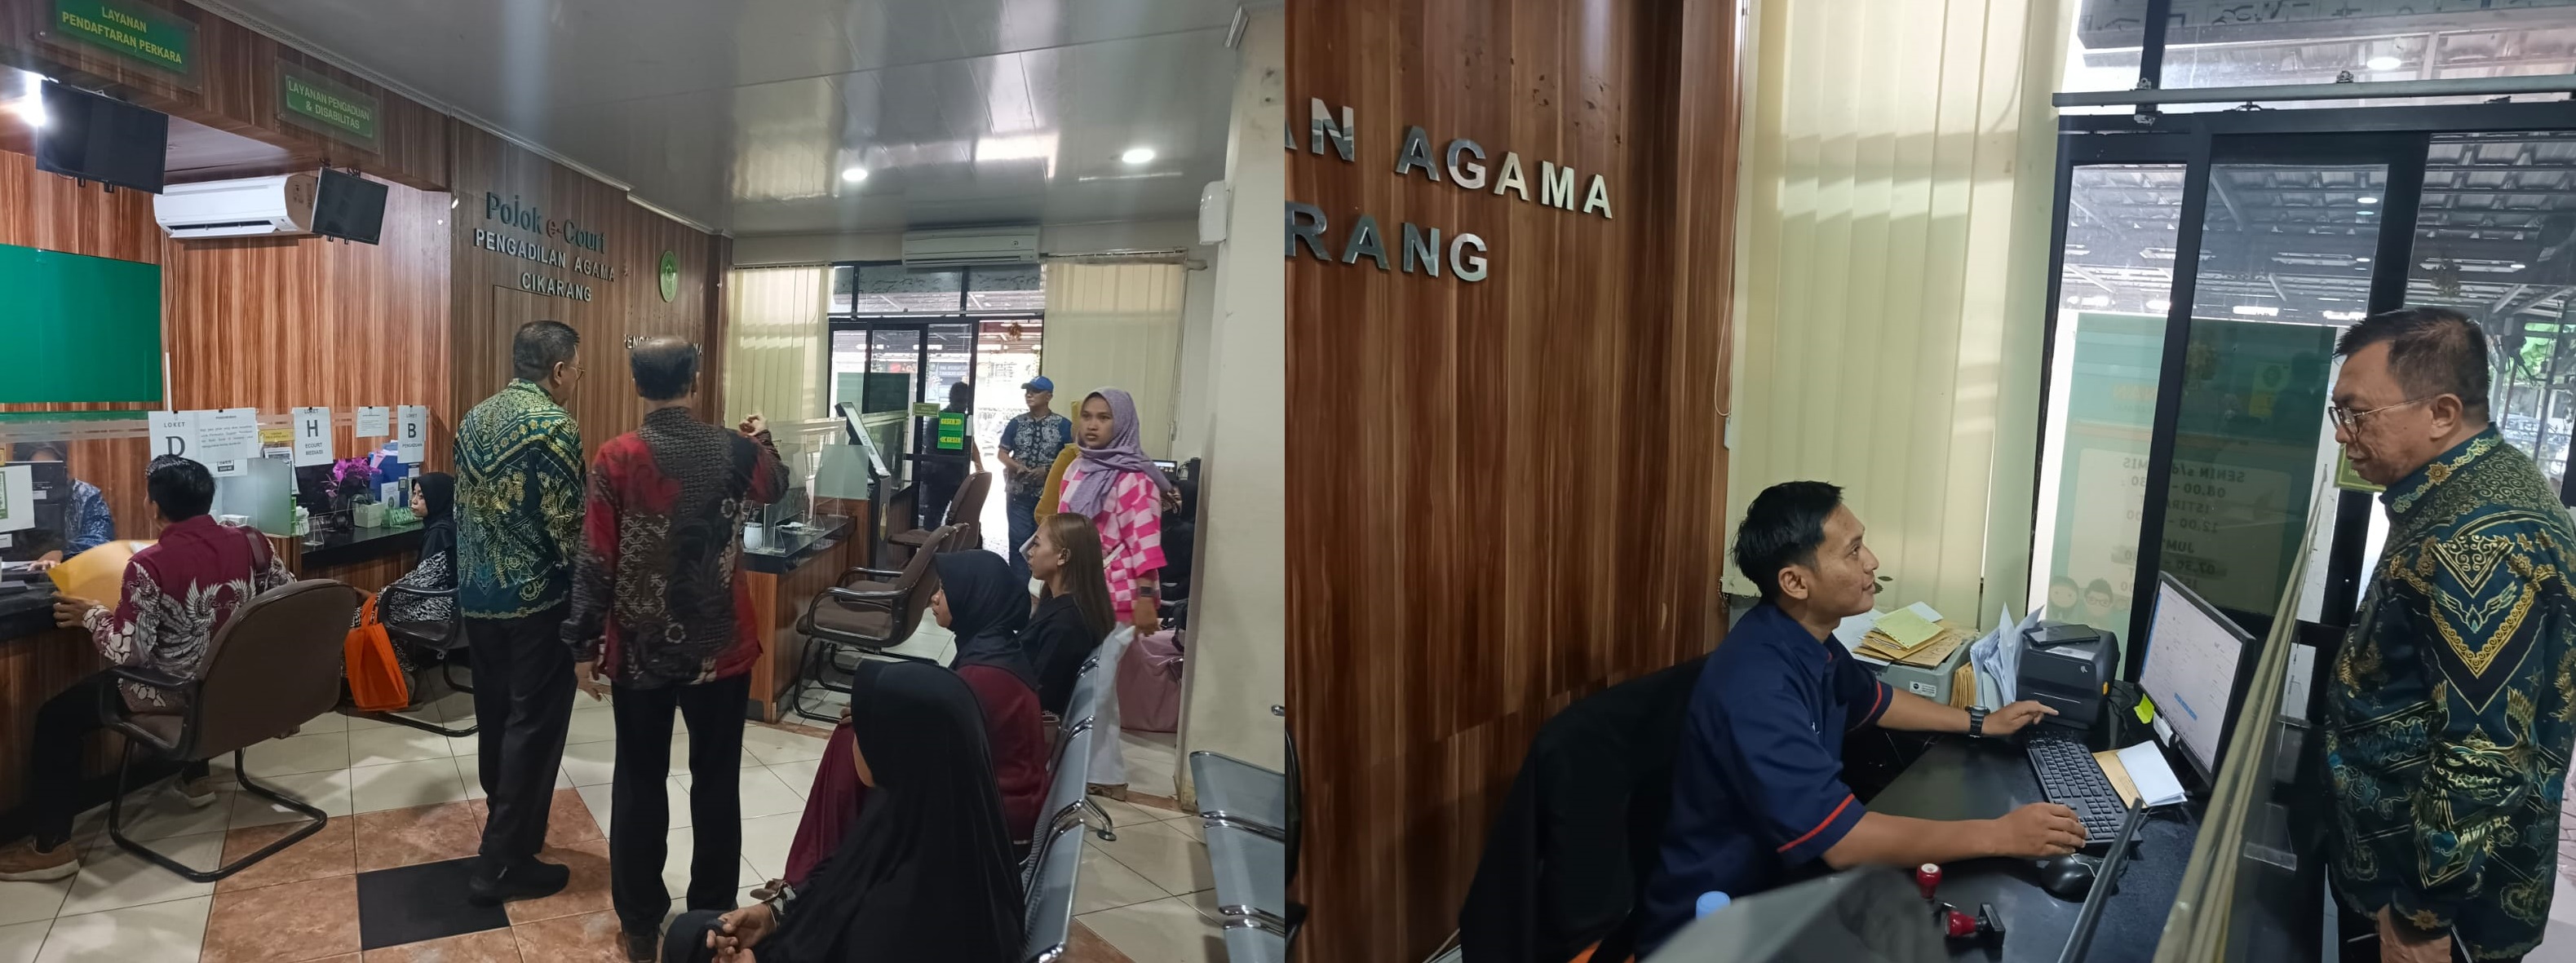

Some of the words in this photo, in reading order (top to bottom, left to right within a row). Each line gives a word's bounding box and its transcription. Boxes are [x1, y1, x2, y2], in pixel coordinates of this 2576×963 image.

[101, 7, 147, 33] LAYANAN
[62, 11, 137, 47] PENDAFTARAN
[139, 40, 182, 64] PERKARA
[288, 80, 326, 104] LAYANAN
[328, 96, 370, 121] PENGADUAN
[306, 100, 312, 112] &
[316, 104, 360, 130] DISABILITAS
[1286, 97, 1355, 162] N
[1394, 126, 1613, 220] AGAMA
[486, 192, 542, 235] Pojok
[547, 219, 605, 254] e-Court
[474, 228, 566, 268] PENGADILAN
[573, 257, 615, 282] AGAMA
[521, 272, 591, 303] CIKARANG
[307, 419, 319, 437] H
[408, 423, 417, 438] B
[166, 435, 185, 457] D
